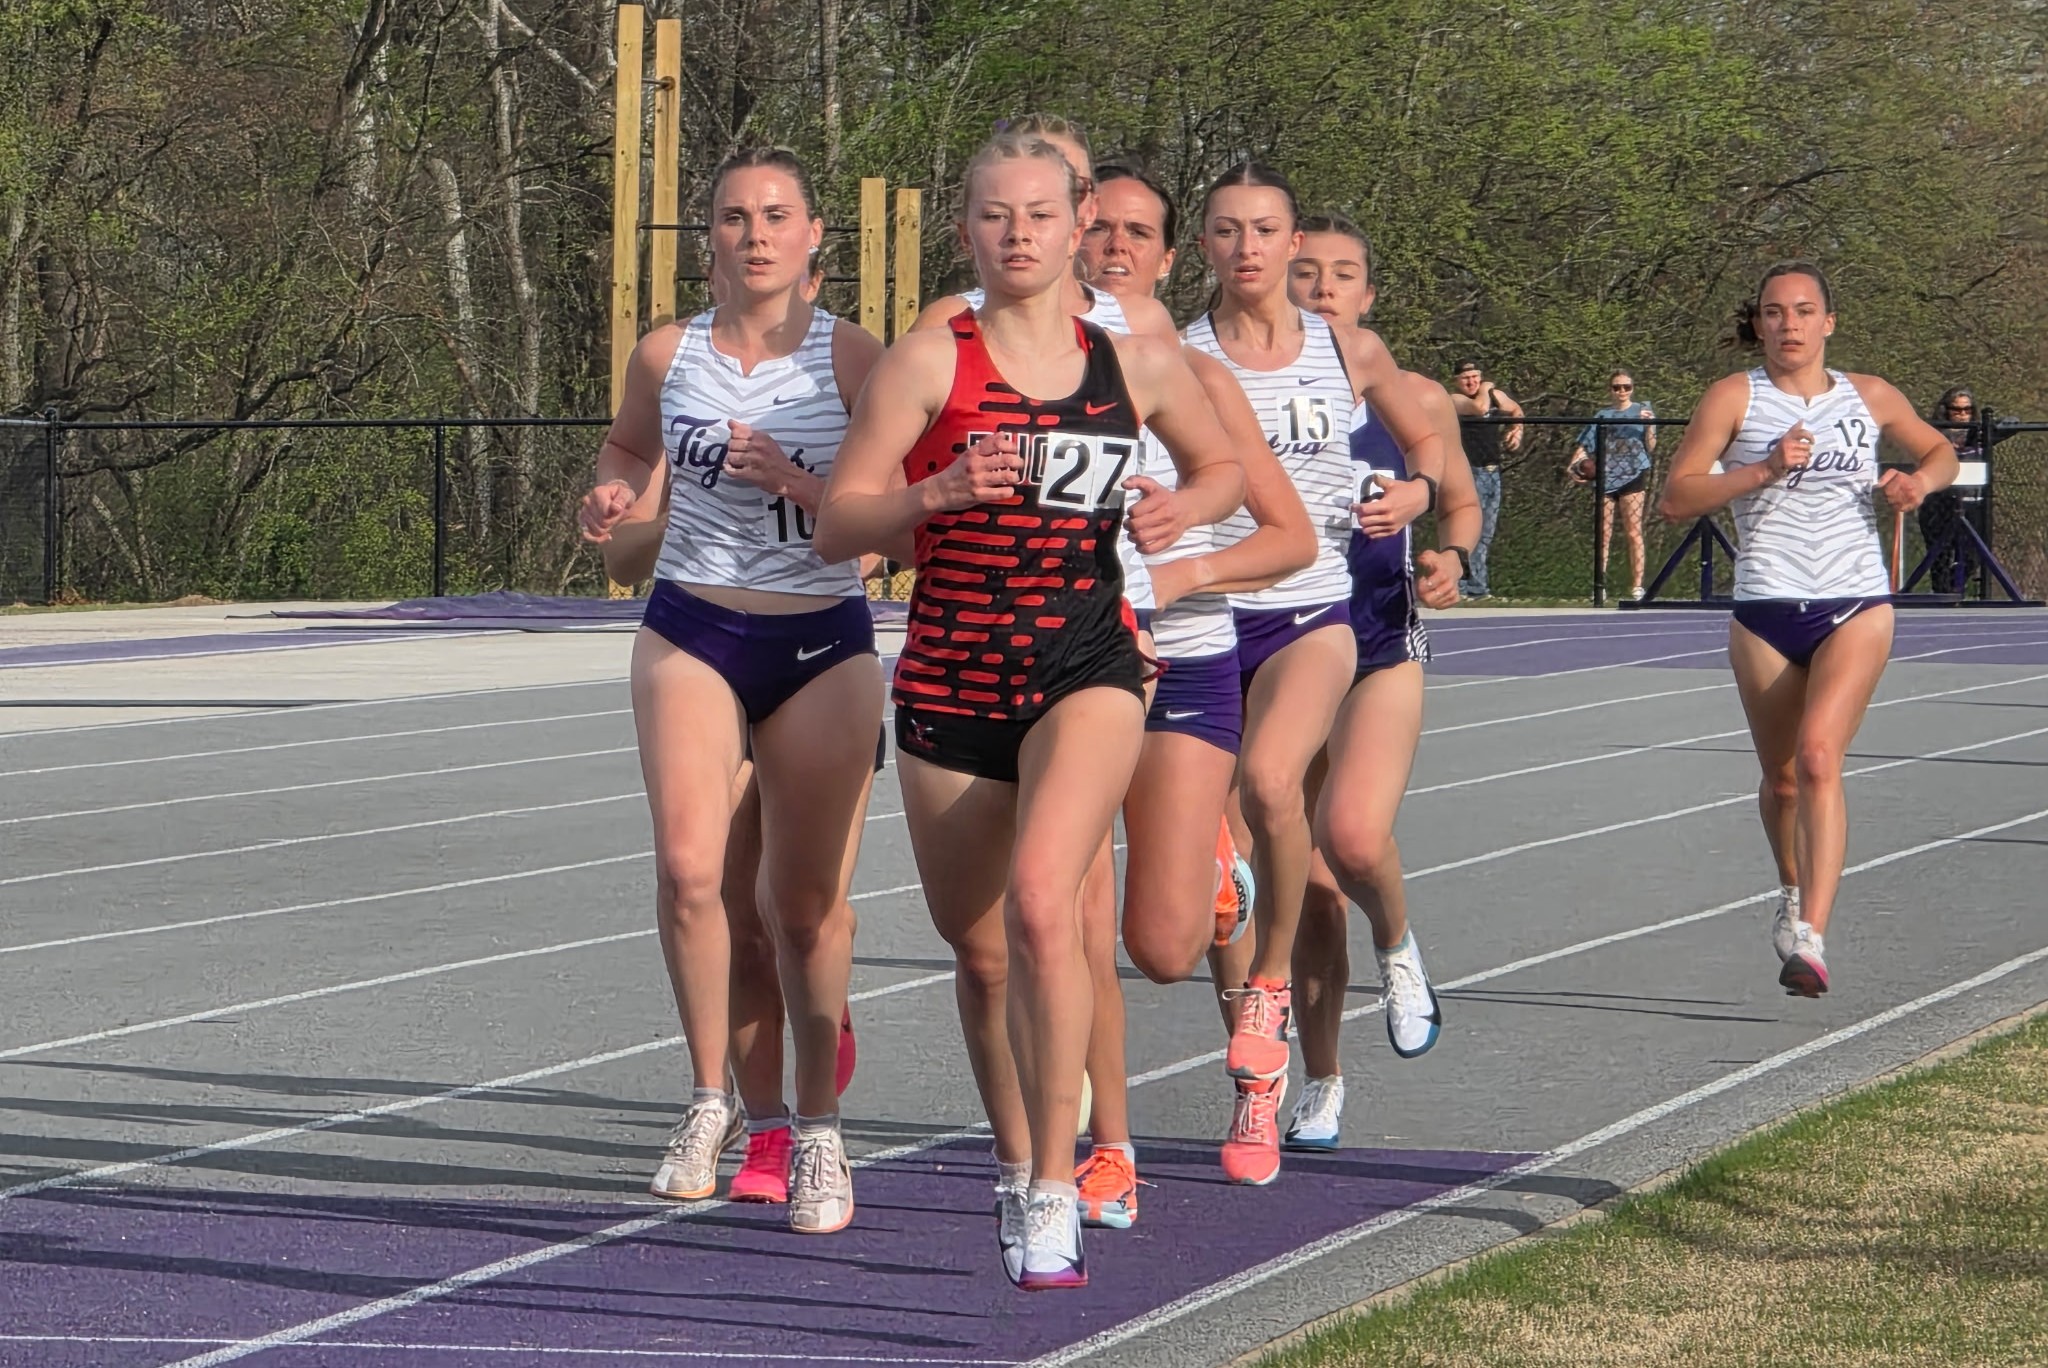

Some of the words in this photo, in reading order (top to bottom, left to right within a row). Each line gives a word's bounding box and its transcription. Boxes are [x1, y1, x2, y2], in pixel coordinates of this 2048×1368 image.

[1281, 397, 1330, 441] 15
[1834, 418, 1870, 449] 12
[1046, 439, 1132, 504] 27
[1767, 438, 1864, 490] gers
